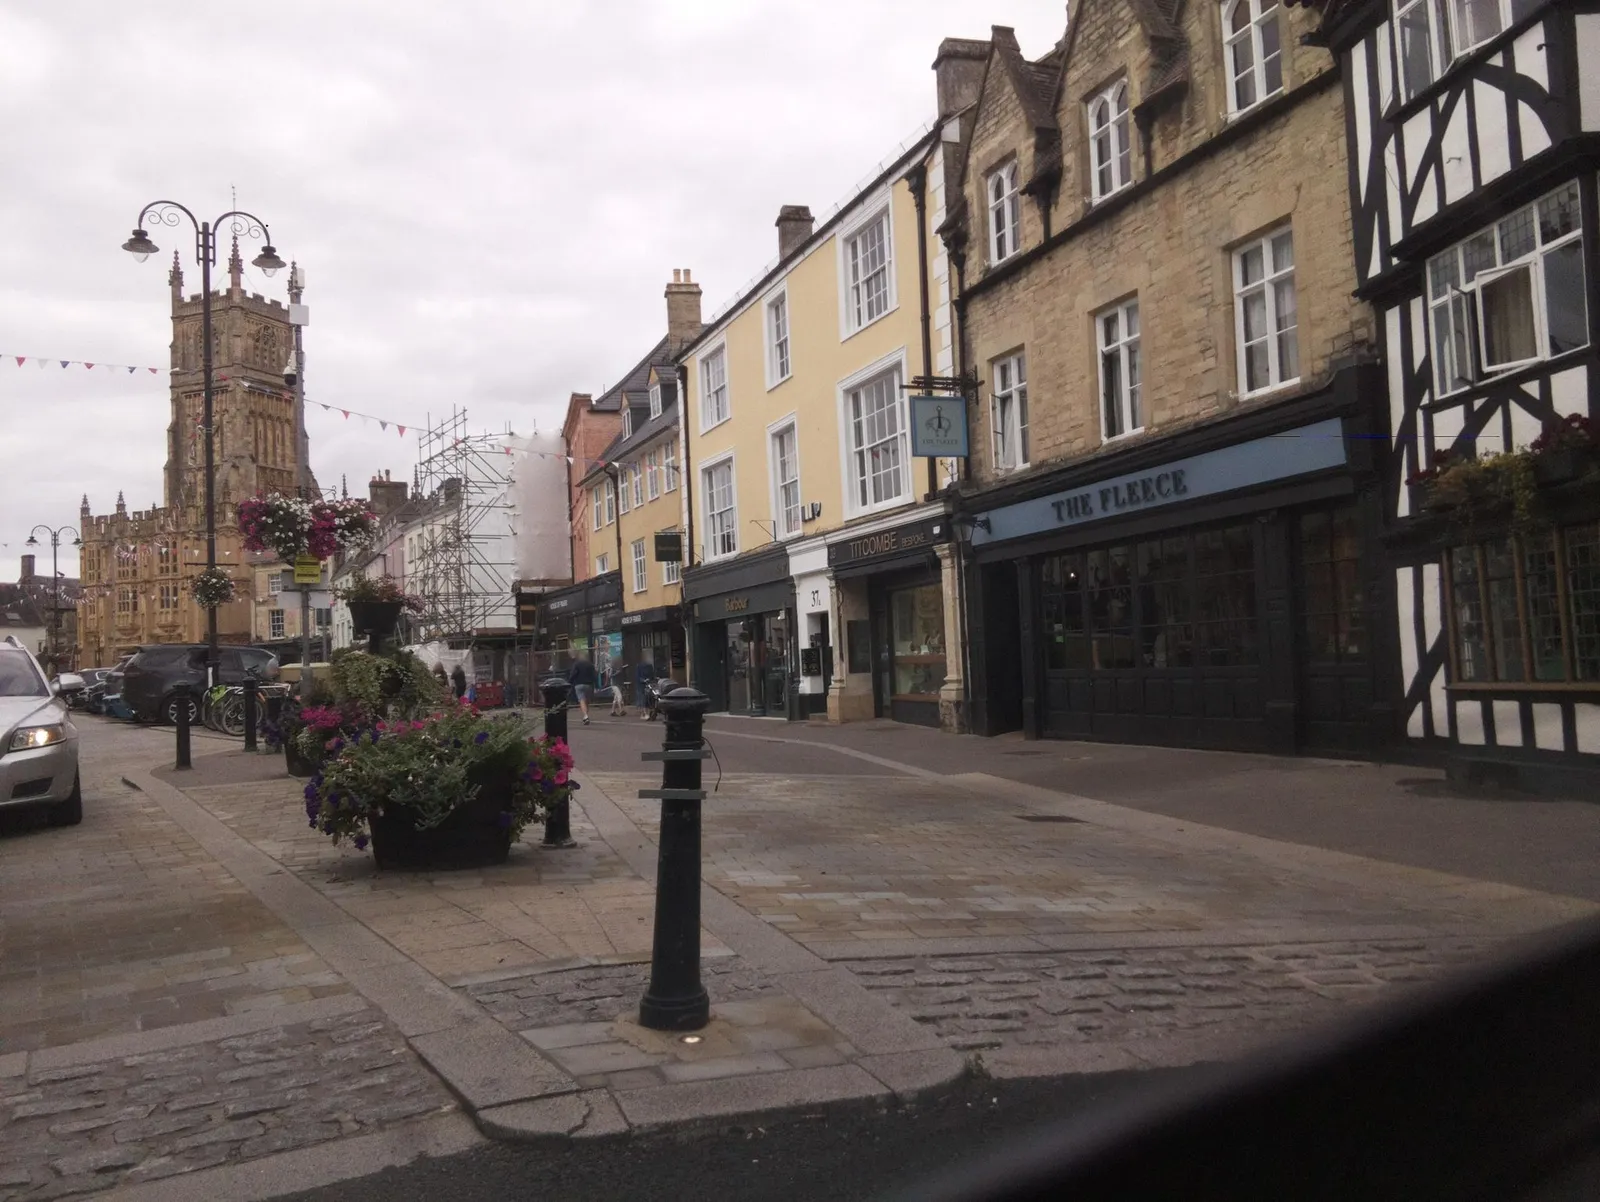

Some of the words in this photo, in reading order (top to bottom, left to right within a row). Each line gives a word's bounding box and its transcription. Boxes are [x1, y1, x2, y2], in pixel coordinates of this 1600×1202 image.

[1051, 493, 1094, 522] THE
[1098, 469, 1188, 512] FLEECE
[849, 531, 898, 558] TITCOMBE
